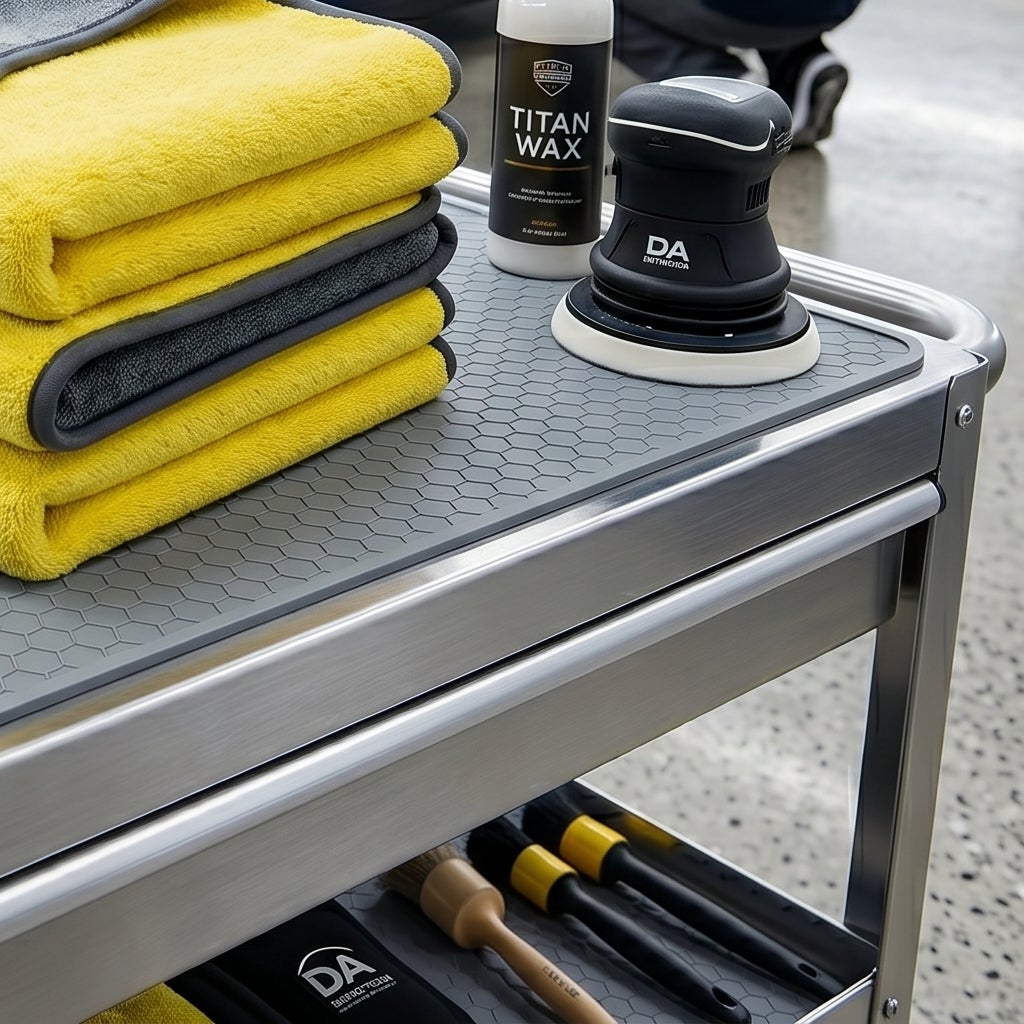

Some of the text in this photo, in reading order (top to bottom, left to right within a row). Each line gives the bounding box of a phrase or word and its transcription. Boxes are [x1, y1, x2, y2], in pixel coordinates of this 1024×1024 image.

[509, 105, 590, 135] TITAN
[515, 133, 582, 160] WAX
[647, 235, 689, 262] DA
[302, 955, 376, 997] DA
